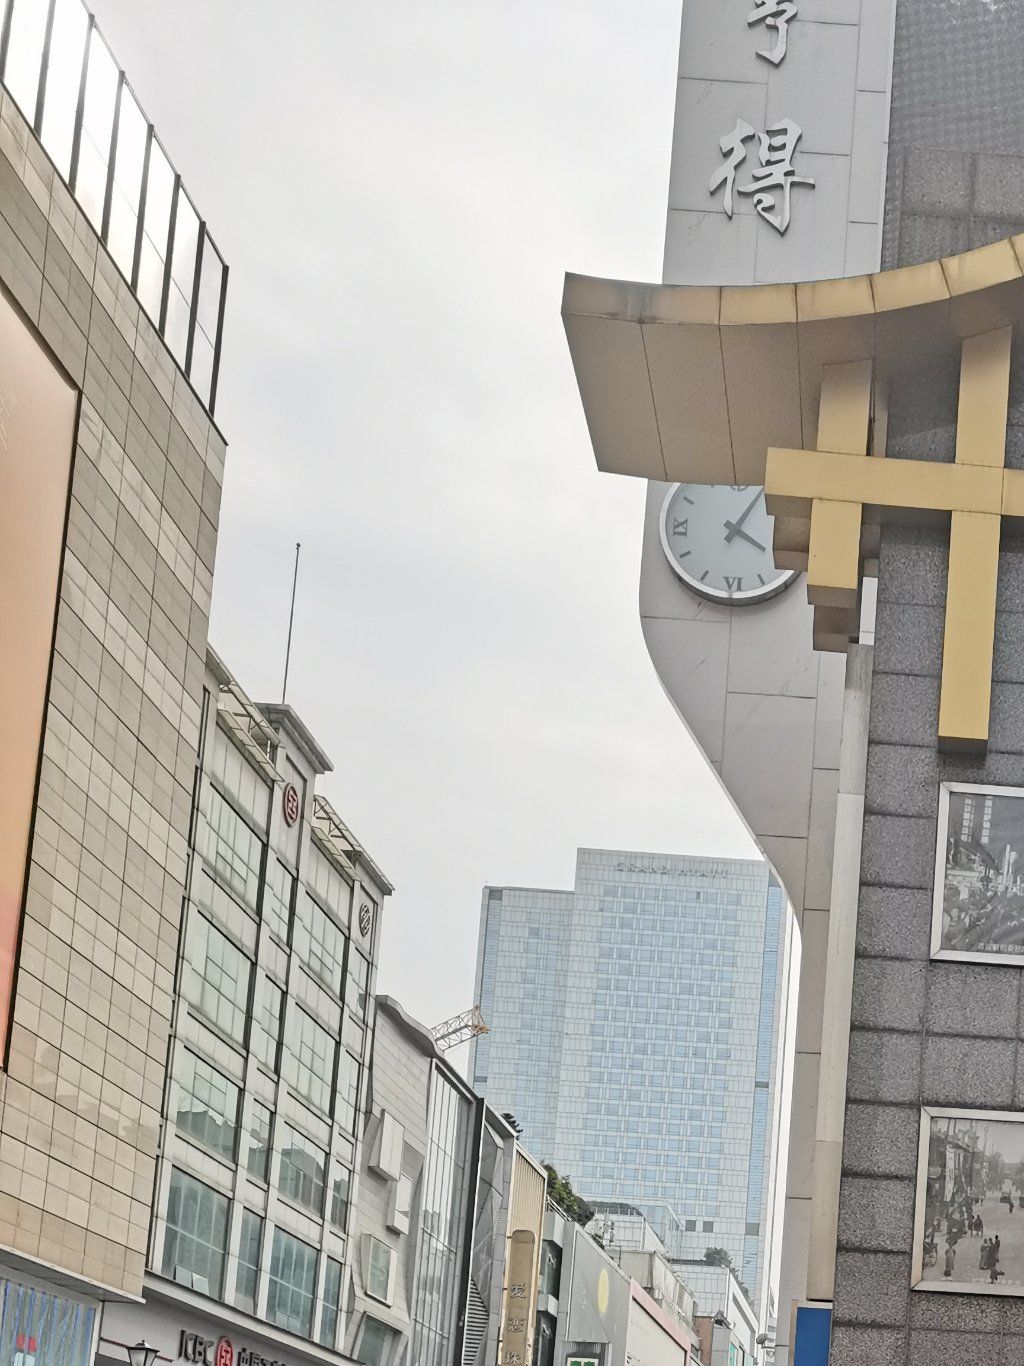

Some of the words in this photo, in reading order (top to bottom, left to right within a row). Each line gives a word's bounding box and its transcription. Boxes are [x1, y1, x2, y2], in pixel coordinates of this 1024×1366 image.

[673, 518, 688, 537] IX
[723, 576, 743, 591] VI
[178, 1330, 214, 1366] ICBC
